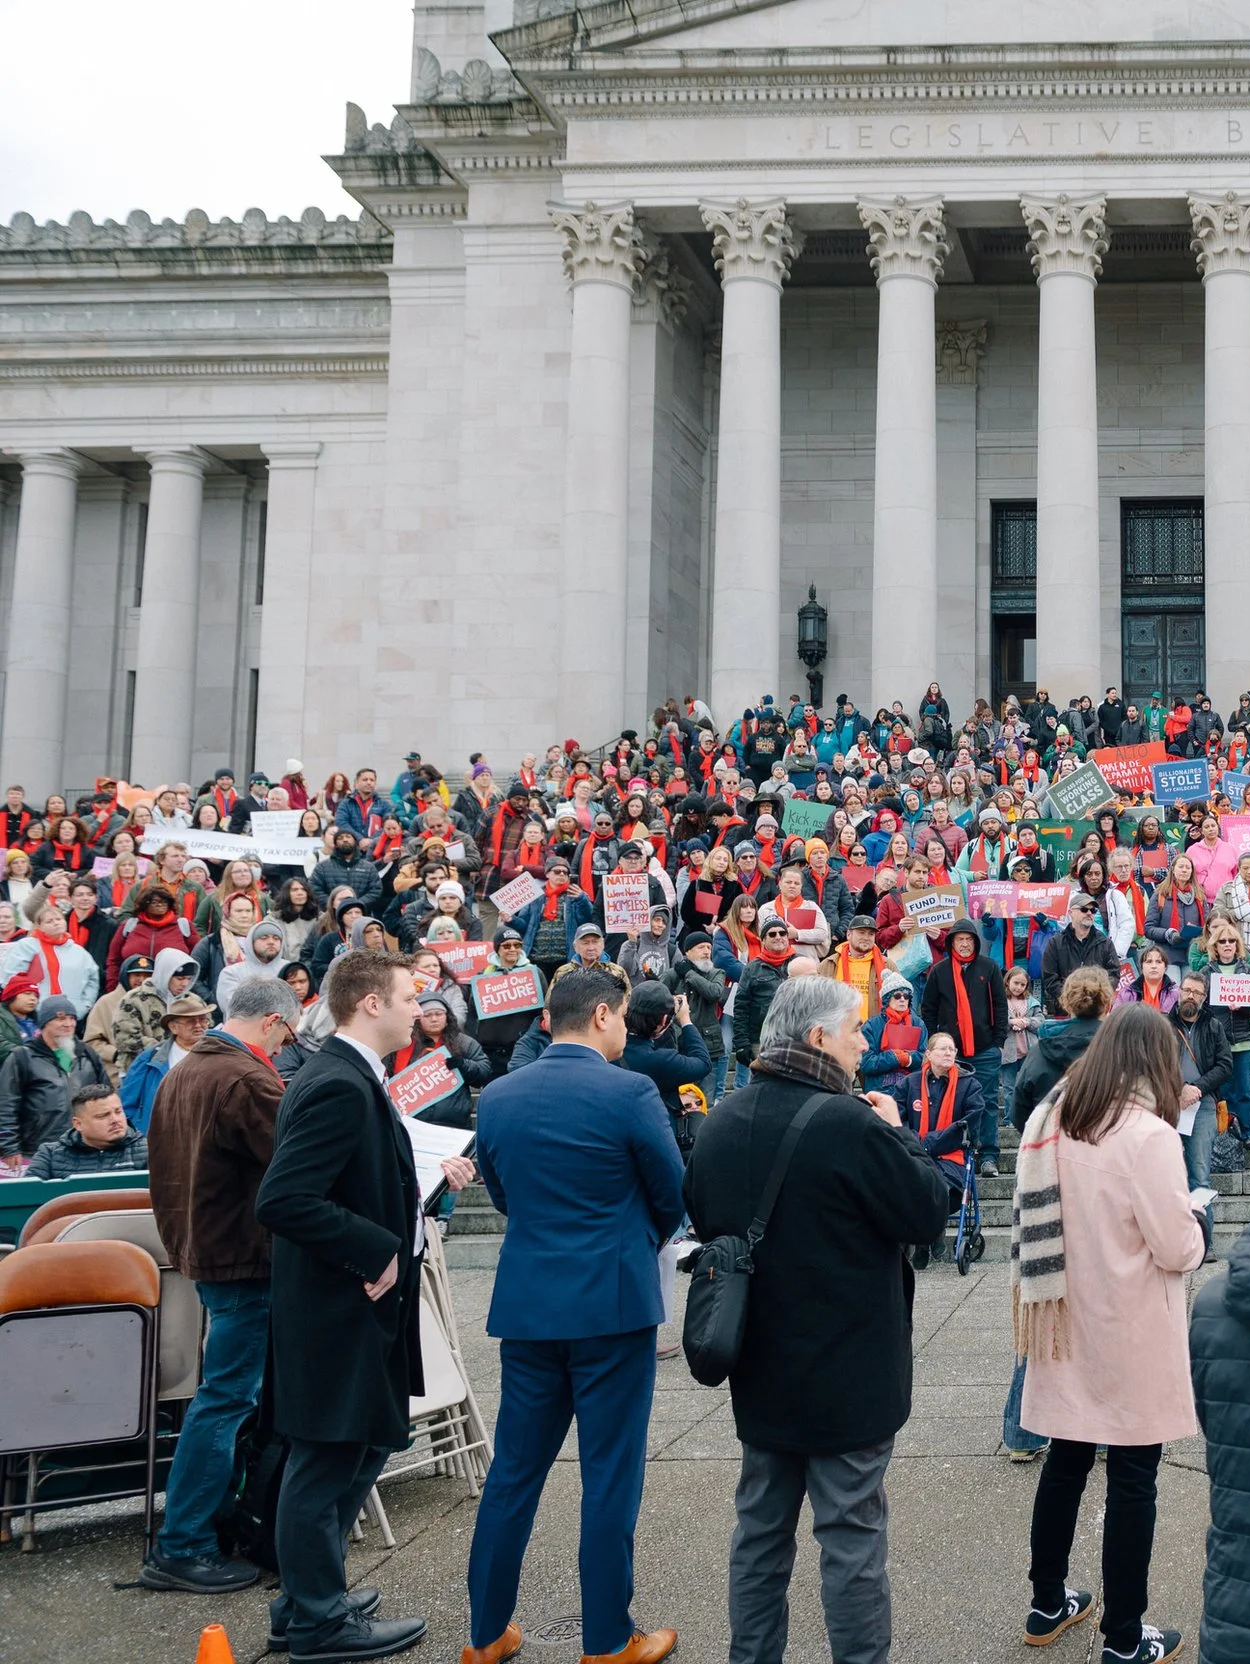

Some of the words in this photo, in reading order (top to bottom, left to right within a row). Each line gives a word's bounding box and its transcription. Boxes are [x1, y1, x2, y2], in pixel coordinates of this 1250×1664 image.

[825, 121, 1154, 150] LEGISLATIVE
[1116, 745, 1149, 761] ALTO
[1158, 768, 1202, 778] BILLIONAIRES
[1160, 774, 1202, 788] STOLE
[1060, 776, 1098, 804] WORKING
[1109, 775, 1151, 789] AMILIA
[1228, 786, 1246, 796] STO
[1066, 784, 1104, 815] CLASS
[788, 809, 810, 826] Kick
[190, 841, 225, 852] UPSIDE
[228, 846, 260, 856] DOWN
[263, 848, 280, 856] TAX
[283, 849, 309, 857] CODE
[496, 888, 512, 901] FULLY
[514, 876, 530, 889] FUND
[606, 875, 648, 886] NATIVES
[970, 884, 980, 892] Tax
[502, 884, 532, 906] HOMELESS
[1018, 887, 1046, 899] People
[1048, 886, 1066, 896] over
[508, 892, 535, 910] SERVICES
[608, 900, 648, 912] HOMELESS
[910, 897, 936, 912] FUND
[606, 916, 628, 925] Before
[630, 914, 650, 924] 1492
[920, 912, 952, 924] PEOPLE
[438, 947, 466, 963] eople
[466, 944, 488, 956] over
[485, 978, 508, 994] Fund
[510, 976, 528, 986] Our
[482, 984, 536, 1009] FUTURE
[396, 1075, 420, 1095] Fund
[420, 1061, 438, 1076] Our
[397, 1065, 453, 1112] FUTURE
